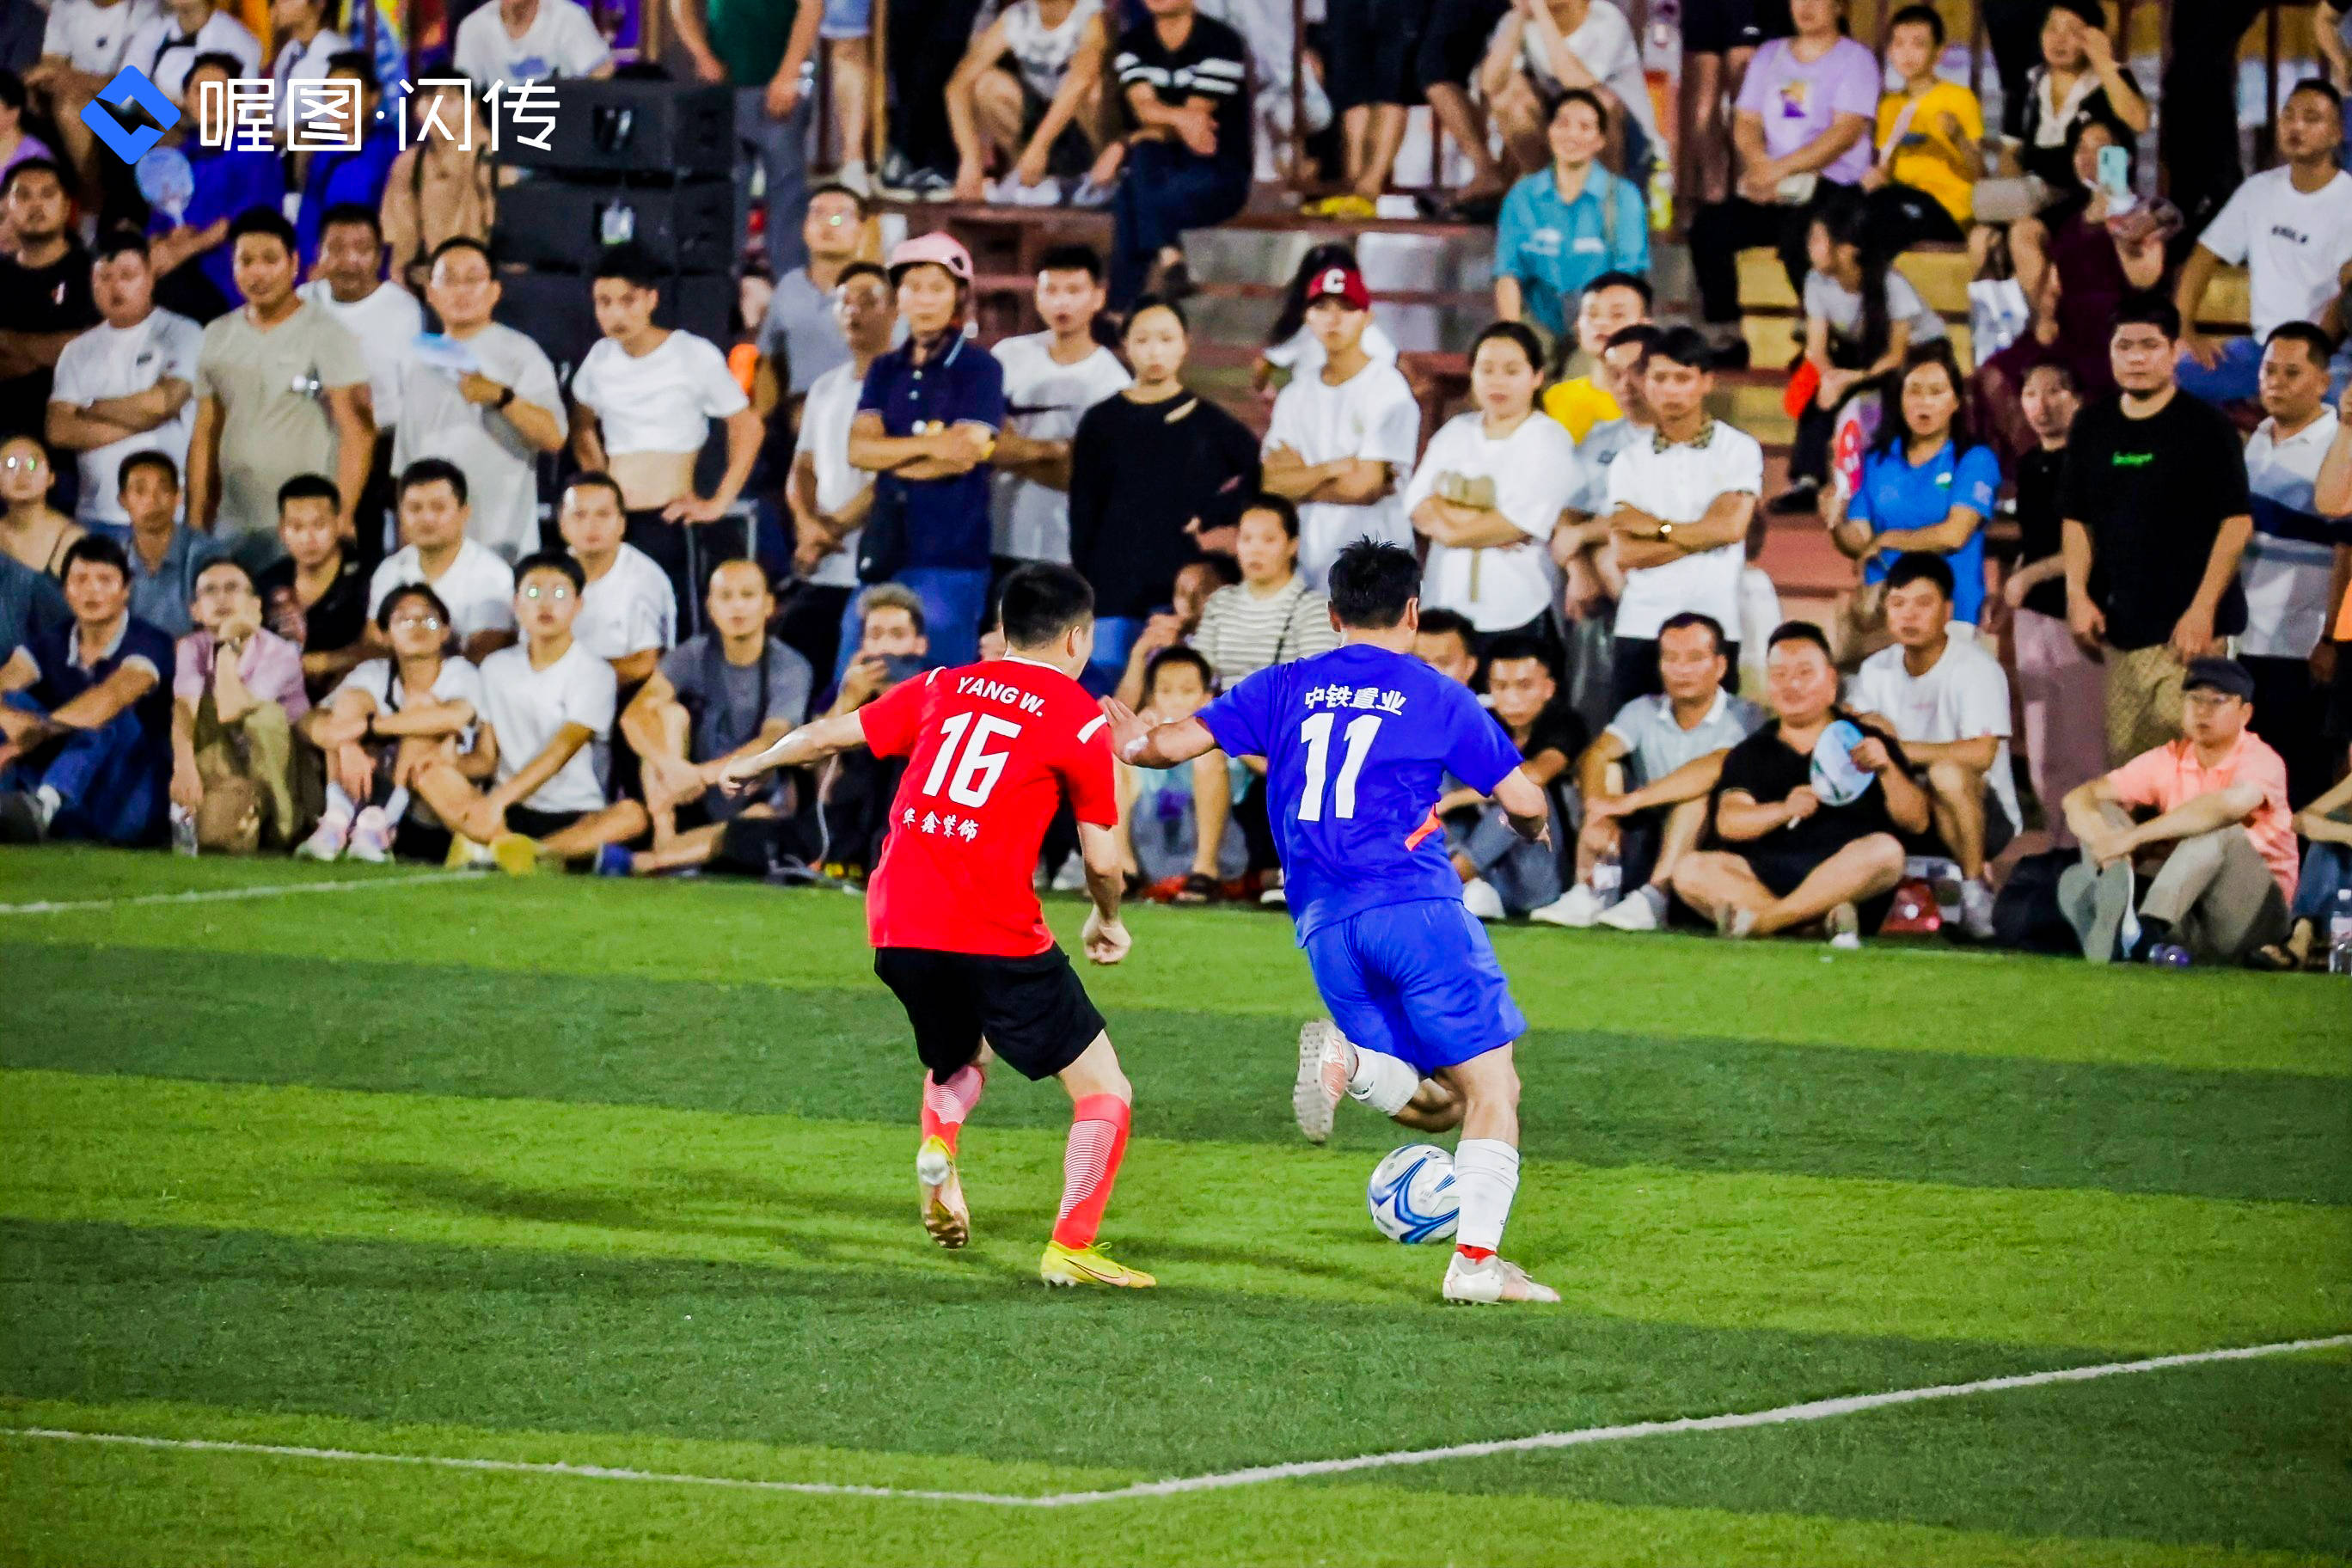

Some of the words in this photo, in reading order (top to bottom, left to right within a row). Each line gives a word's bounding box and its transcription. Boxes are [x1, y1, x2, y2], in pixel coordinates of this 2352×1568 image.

[1322, 268, 1345, 293] C
[956, 677, 1020, 704] YANG
[1019, 692, 1045, 718] W.
[1304, 683, 1407, 716] 中铁置业
[922, 711, 1023, 808] 16
[1297, 712, 1383, 822] 11
